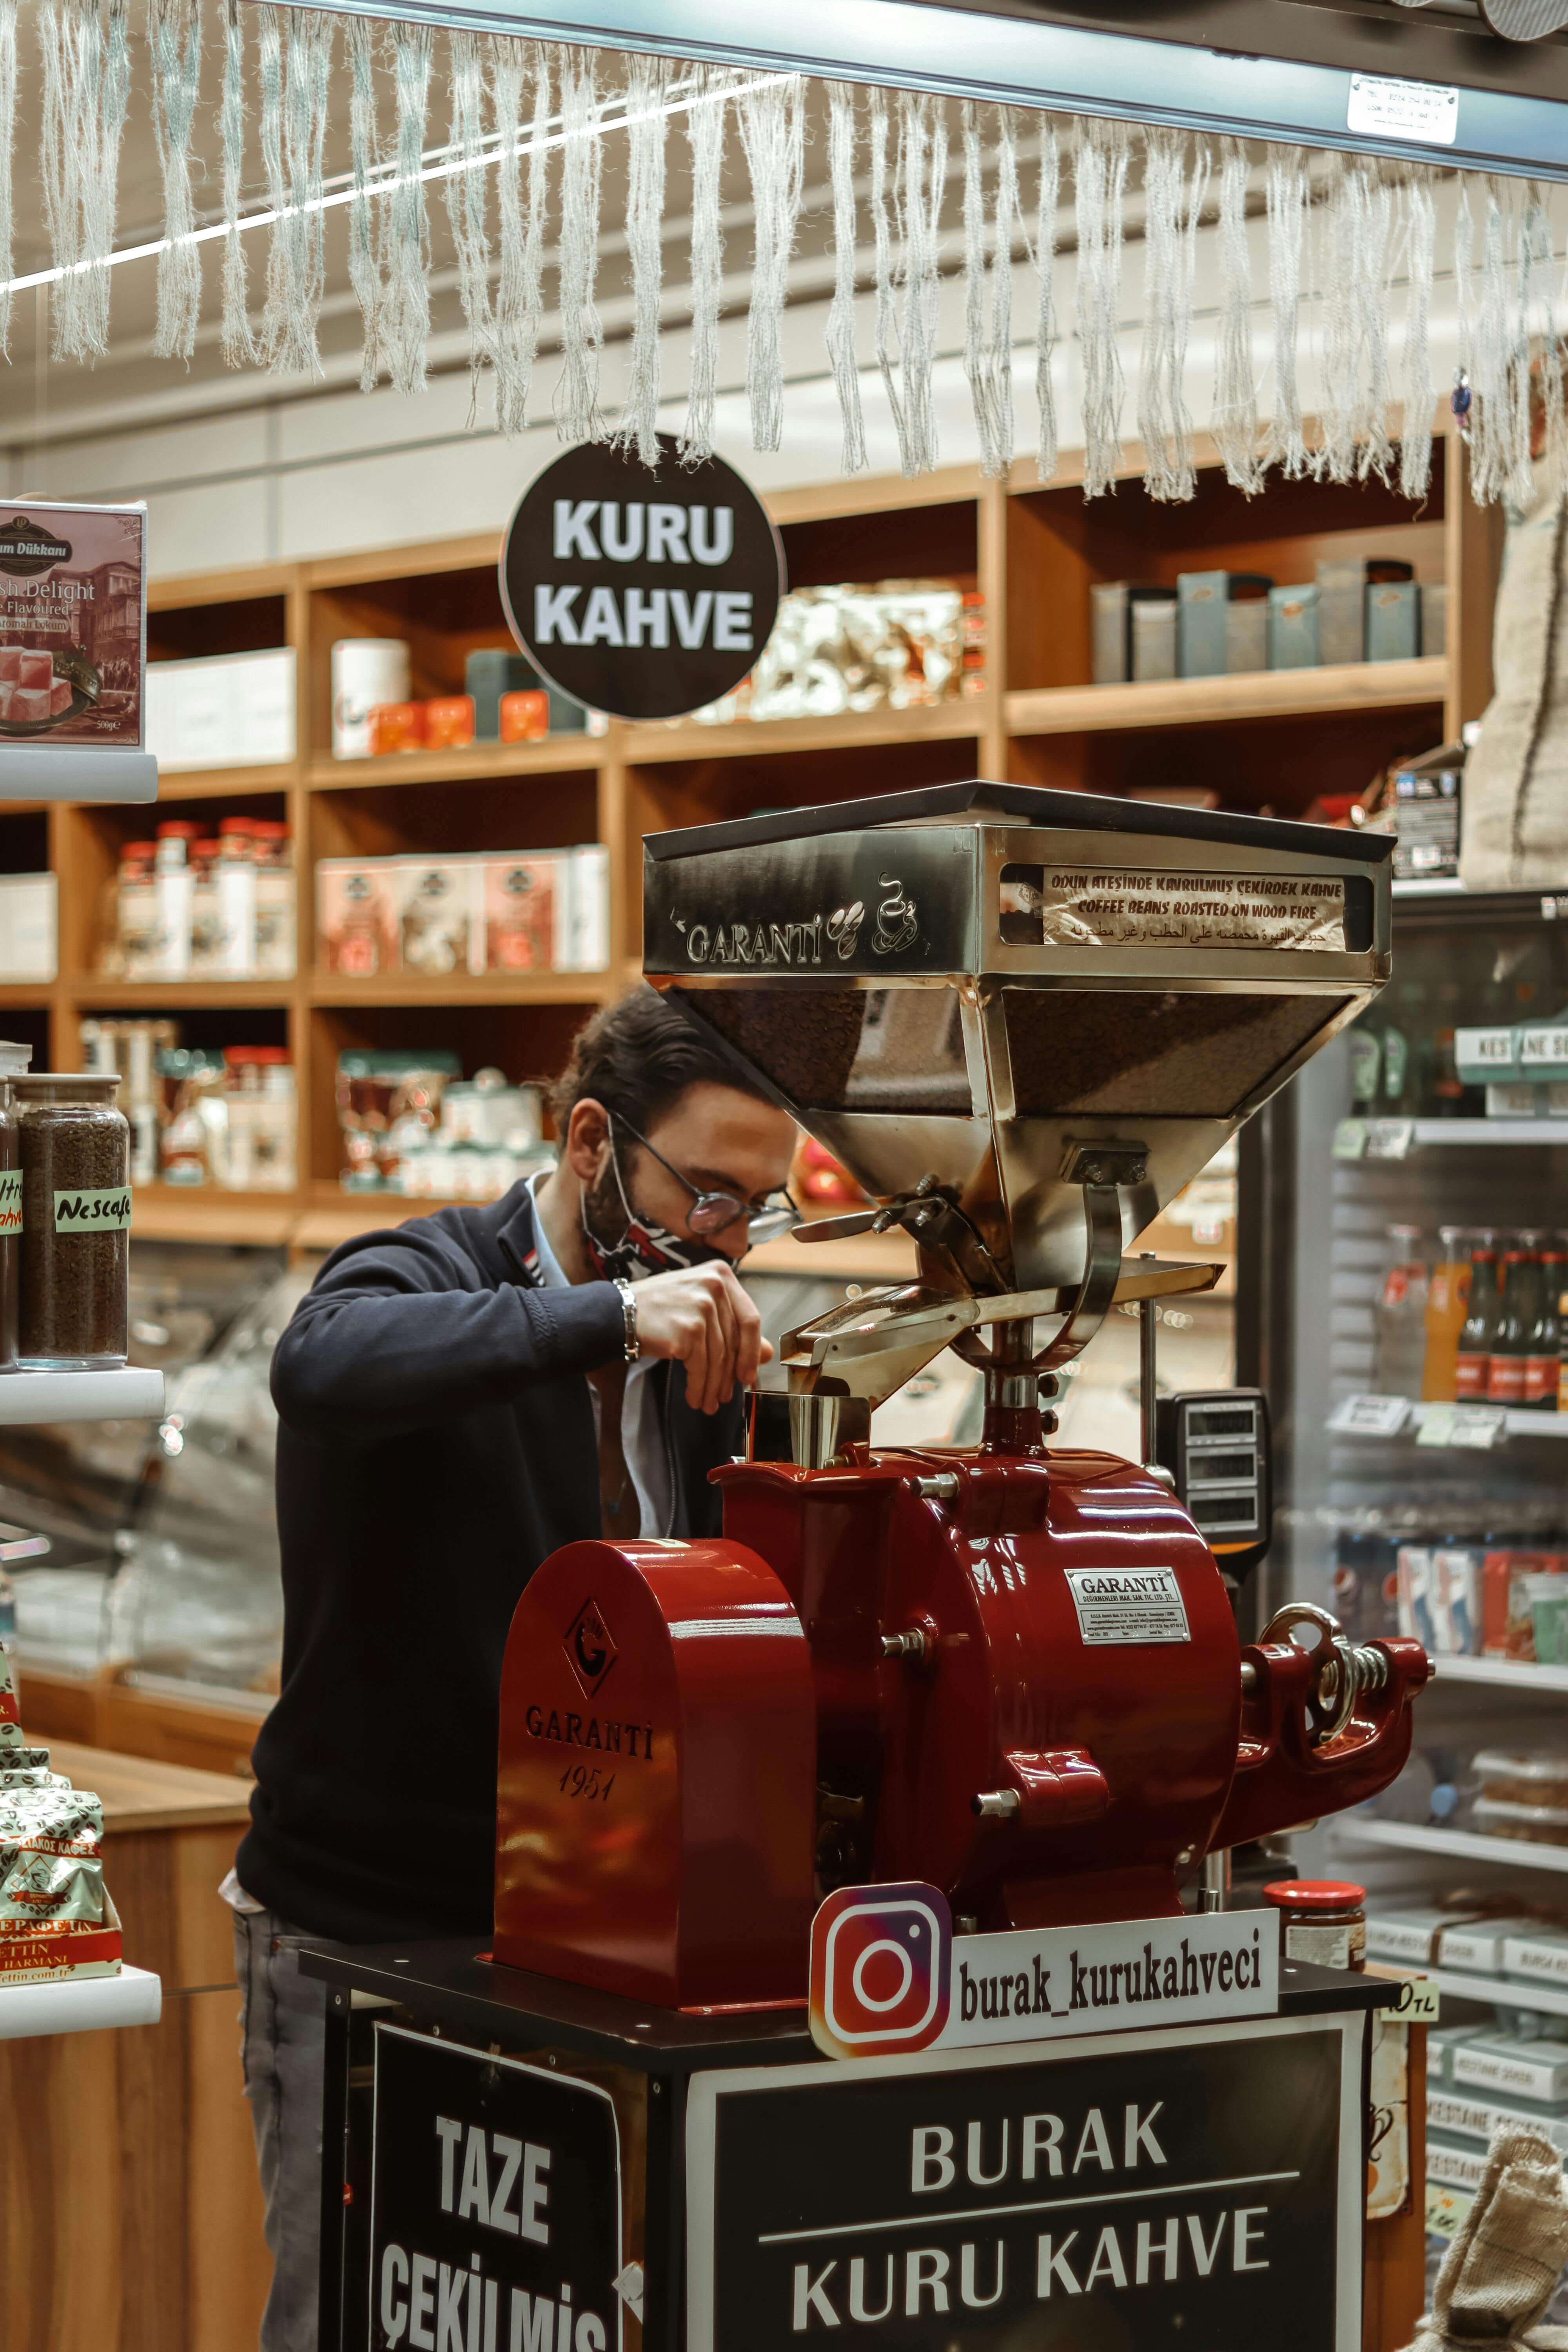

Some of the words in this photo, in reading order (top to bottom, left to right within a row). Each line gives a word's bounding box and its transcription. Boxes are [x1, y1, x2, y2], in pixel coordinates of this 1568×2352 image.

[553, 499, 734, 566] KURU
[16, 543, 66, 556] Dükkanı
[26, 580, 95, 604] Delight
[7, 601, 69, 615] Flavoured
[534, 584, 753, 652] KAHVE
[34, 620, 66, 630] Lokum
[1051, 875, 1088, 889] ODUN
[1092, 874, 1152, 891] ATEŞİNDE
[1156, 877, 1233, 895] KAVRULMUŞ
[1236, 878, 1298, 896] ÇEKİRDEK
[1301, 884, 1341, 897] KAHVE
[1078, 899, 1125, 913] COFFEE
[1128, 900, 1169, 915] BEANS
[1173, 902, 1229, 916] ROASTED
[1231, 903, 1249, 916] ON
[1252, 904, 1287, 918] WOOD
[1290, 905, 1317, 919] FIRE
[687, 914, 821, 964] GARANTİ
[57, 1194, 130, 1225] Nescafe
[1081, 1573, 1169, 1594] GARANTİ
[1083, 1593, 1118, 1602] DEĞİRMENLERİ
[525, 1705, 653, 1760] GARANTİ
[559, 1766, 615, 1800] 1951
[4, 1955, 67, 1969] HARMANI
[960, 1927, 1261, 2022] burak_kurukahveci
[911, 2101, 1167, 2192] BURAK
[436, 2116, 550, 2245] TAZE
[793, 2239, 1004, 2331] KURU
[1037, 2206, 1270, 2299] KAHVE
